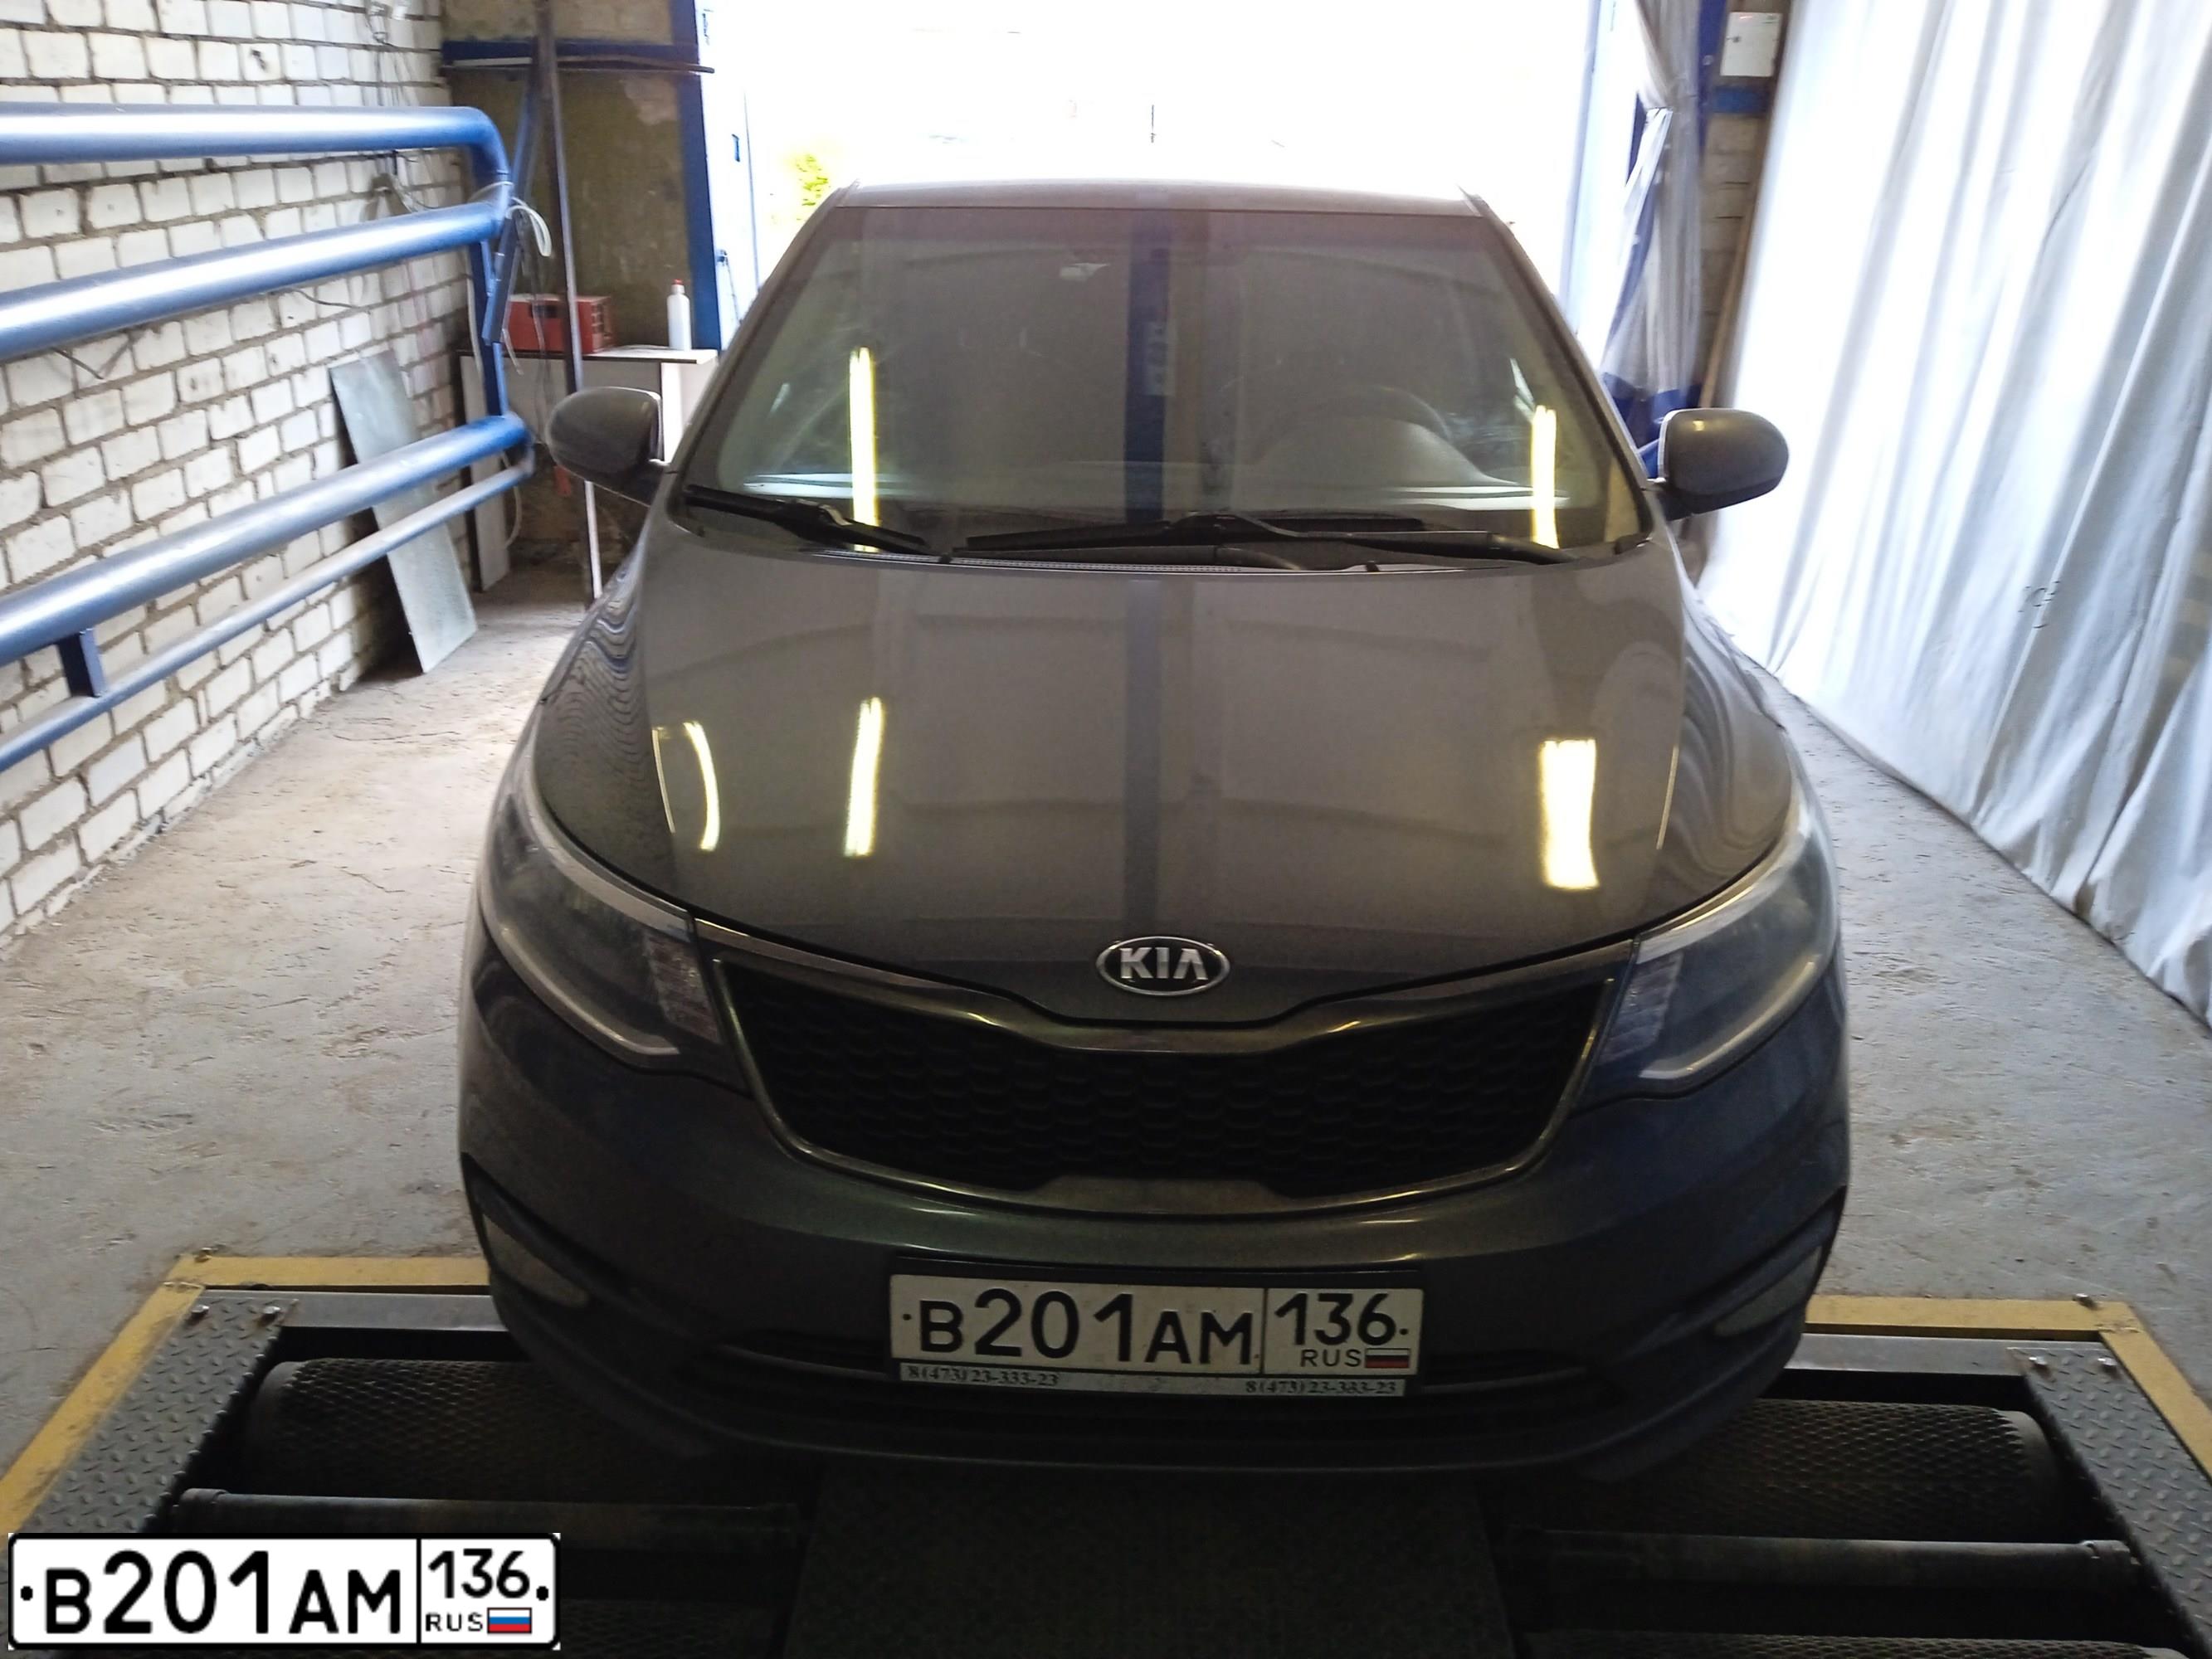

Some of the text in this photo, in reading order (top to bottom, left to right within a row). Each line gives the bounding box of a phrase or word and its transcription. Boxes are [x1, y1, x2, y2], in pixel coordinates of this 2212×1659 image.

[1119, 946, 1209, 980] KIA
[1275, 1292, 1396, 1346] 136
[1300, 1349, 1362, 1367] RUS
